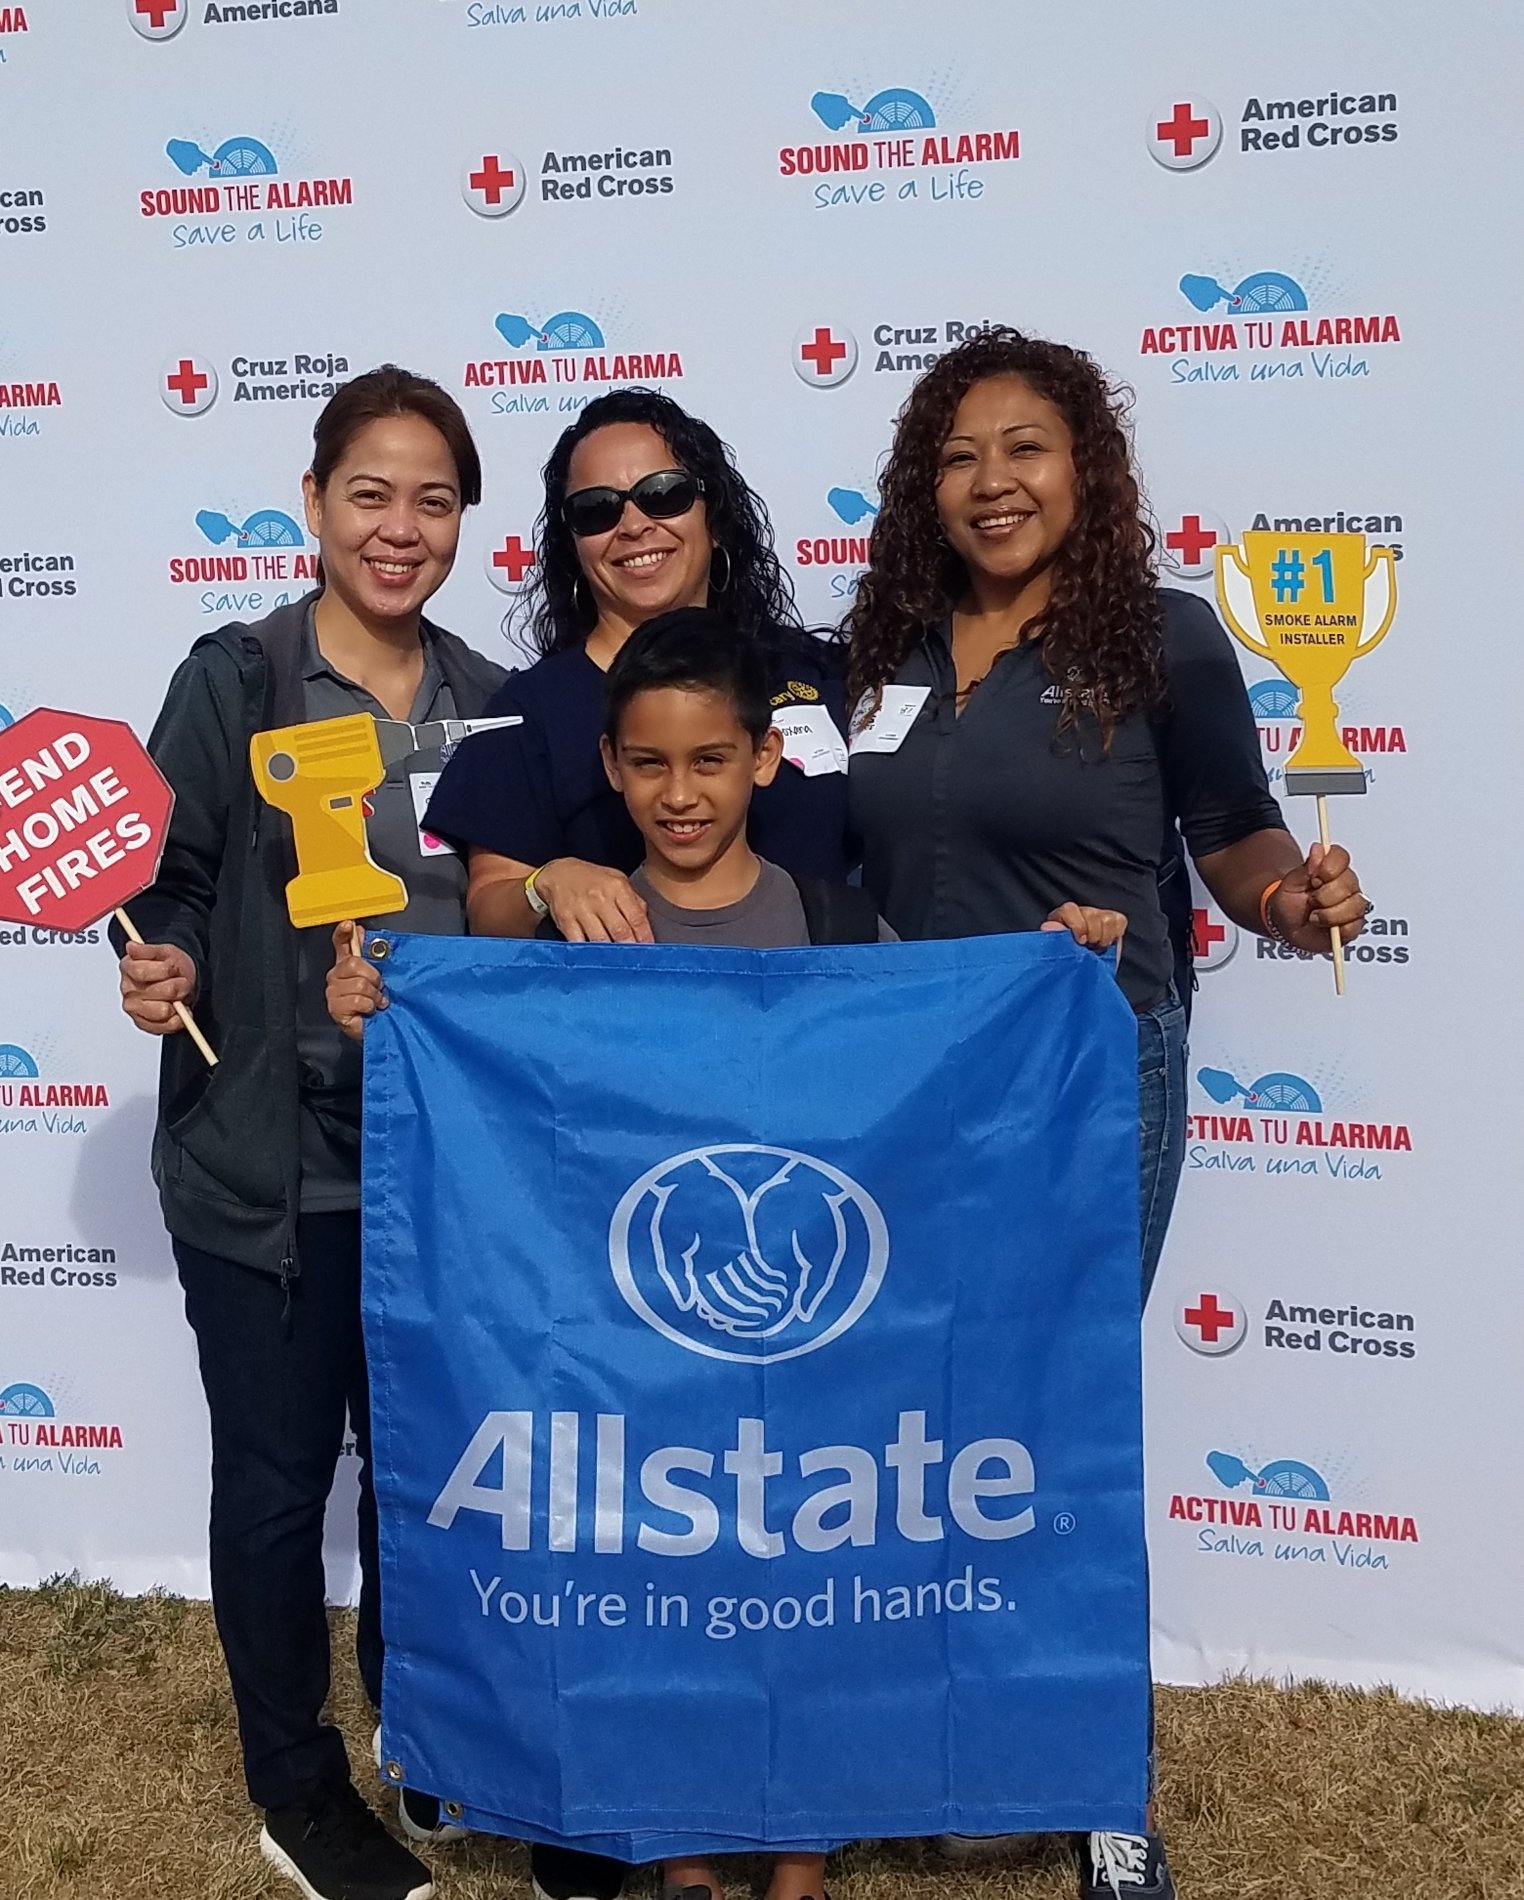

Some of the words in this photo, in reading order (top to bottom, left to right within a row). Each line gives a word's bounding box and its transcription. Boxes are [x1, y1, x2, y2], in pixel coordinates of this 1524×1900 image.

[203, 0, 338, 24] Americana
[467, 3, 526, 27] Salva
[535, 5, 582, 22] una
[1241, 92, 1397, 122] American
[1241, 124, 1299, 151] Red
[1307, 122, 1398, 147] Cross
[541, 148, 672, 174] American
[780, 143, 868, 175] SOUND
[873, 139, 915, 168] THE
[921, 131, 1020, 165] ALARM
[140, 188, 219, 216] SOUND
[223, 184, 261, 211] THE
[267, 178, 352, 208] ALARM
[542, 177, 591, 200] Red
[597, 175, 673, 196] Cross
[814, 182, 885, 208] Save
[898, 181, 917, 200] a
[932, 169, 984, 200] Life
[173, 223, 236, 248] Save
[247, 221, 265, 239] a
[276, 212, 322, 242] Life
[874, 324, 937, 346] Cruz
[1140, 325, 1237, 354] ACTIVA
[1244, 322, 1273, 349] TU
[1280, 316, 1401, 347] ALARMA
[231, 357, 288, 378] Cruz
[294, 353, 349, 378] Roja
[464, 359, 547, 387] ACTIVA
[551, 357, 576, 383] TU
[583, 353, 683, 382] ALARMA
[1171, 359, 1239, 384] Salva
[1250, 361, 1303, 381] una
[1311, 352, 1369, 378] Vida
[0, 383, 61, 408] ARMA
[233, 379, 347, 402] America
[491, 392, 549, 414] Salva
[558, 396, 601, 413] un
[1251, 512, 1403, 533] American
[0, 552, 74, 573] erican
[170, 556, 248, 582] SOUND
[251, 555, 288, 580] THE
[1271, 549, 1335, 603] #1
[8, 577, 77, 597] Cross
[200, 591, 263, 614] Save
[1265, 614, 1311, 626] SMOKE
[1314, 615, 1357, 626] ALARM
[1280, 633, 1345, 645] INSTALLER
[0, 732, 91, 809] END
[0, 766, 129, 873] HOME
[15, 812, 152, 916] FIRES
[19, 1085, 109, 1107] ALARMA
[42, 1111, 87, 1134] Vida
[1260, 1119, 1288, 1144] TU
[1295, 1121, 1413, 1151] ALARMA
[1189, 1146, 1256, 1172] Salva
[1266, 1158, 1318, 1175] una
[1324, 1152, 1382, 1180] Vida
[0, 1243, 116, 1263] American
[1, 1267, 45, 1286] Red
[50, 1267, 117, 1287] Cross
[1265, 1299, 1415, 1331] American
[1265, 1326, 1322, 1351] Red
[1328, 1331, 1416, 1359] Cross
[8, 1423, 29, 1446] TU
[35, 1424, 123, 1448] ALARMA
[13, 1457, 53, 1472] una
[58, 1451, 101, 1475] Vida
[426, 1410, 1037, 1559] Allstate
[1169, 1495, 1262, 1528] ACTIVA
[1268, 1504, 1297, 1531] TU
[1304, 1508, 1419, 1543] ALARMA
[1198, 1528, 1265, 1557] Salva
[1274, 1543, 1326, 1563] una
[1332, 1540, 1390, 1571] Vida
[645, 1582, 689, 1628] in
[704, 1577, 836, 1640] good
[854, 1564, 1017, 1623] hands.
